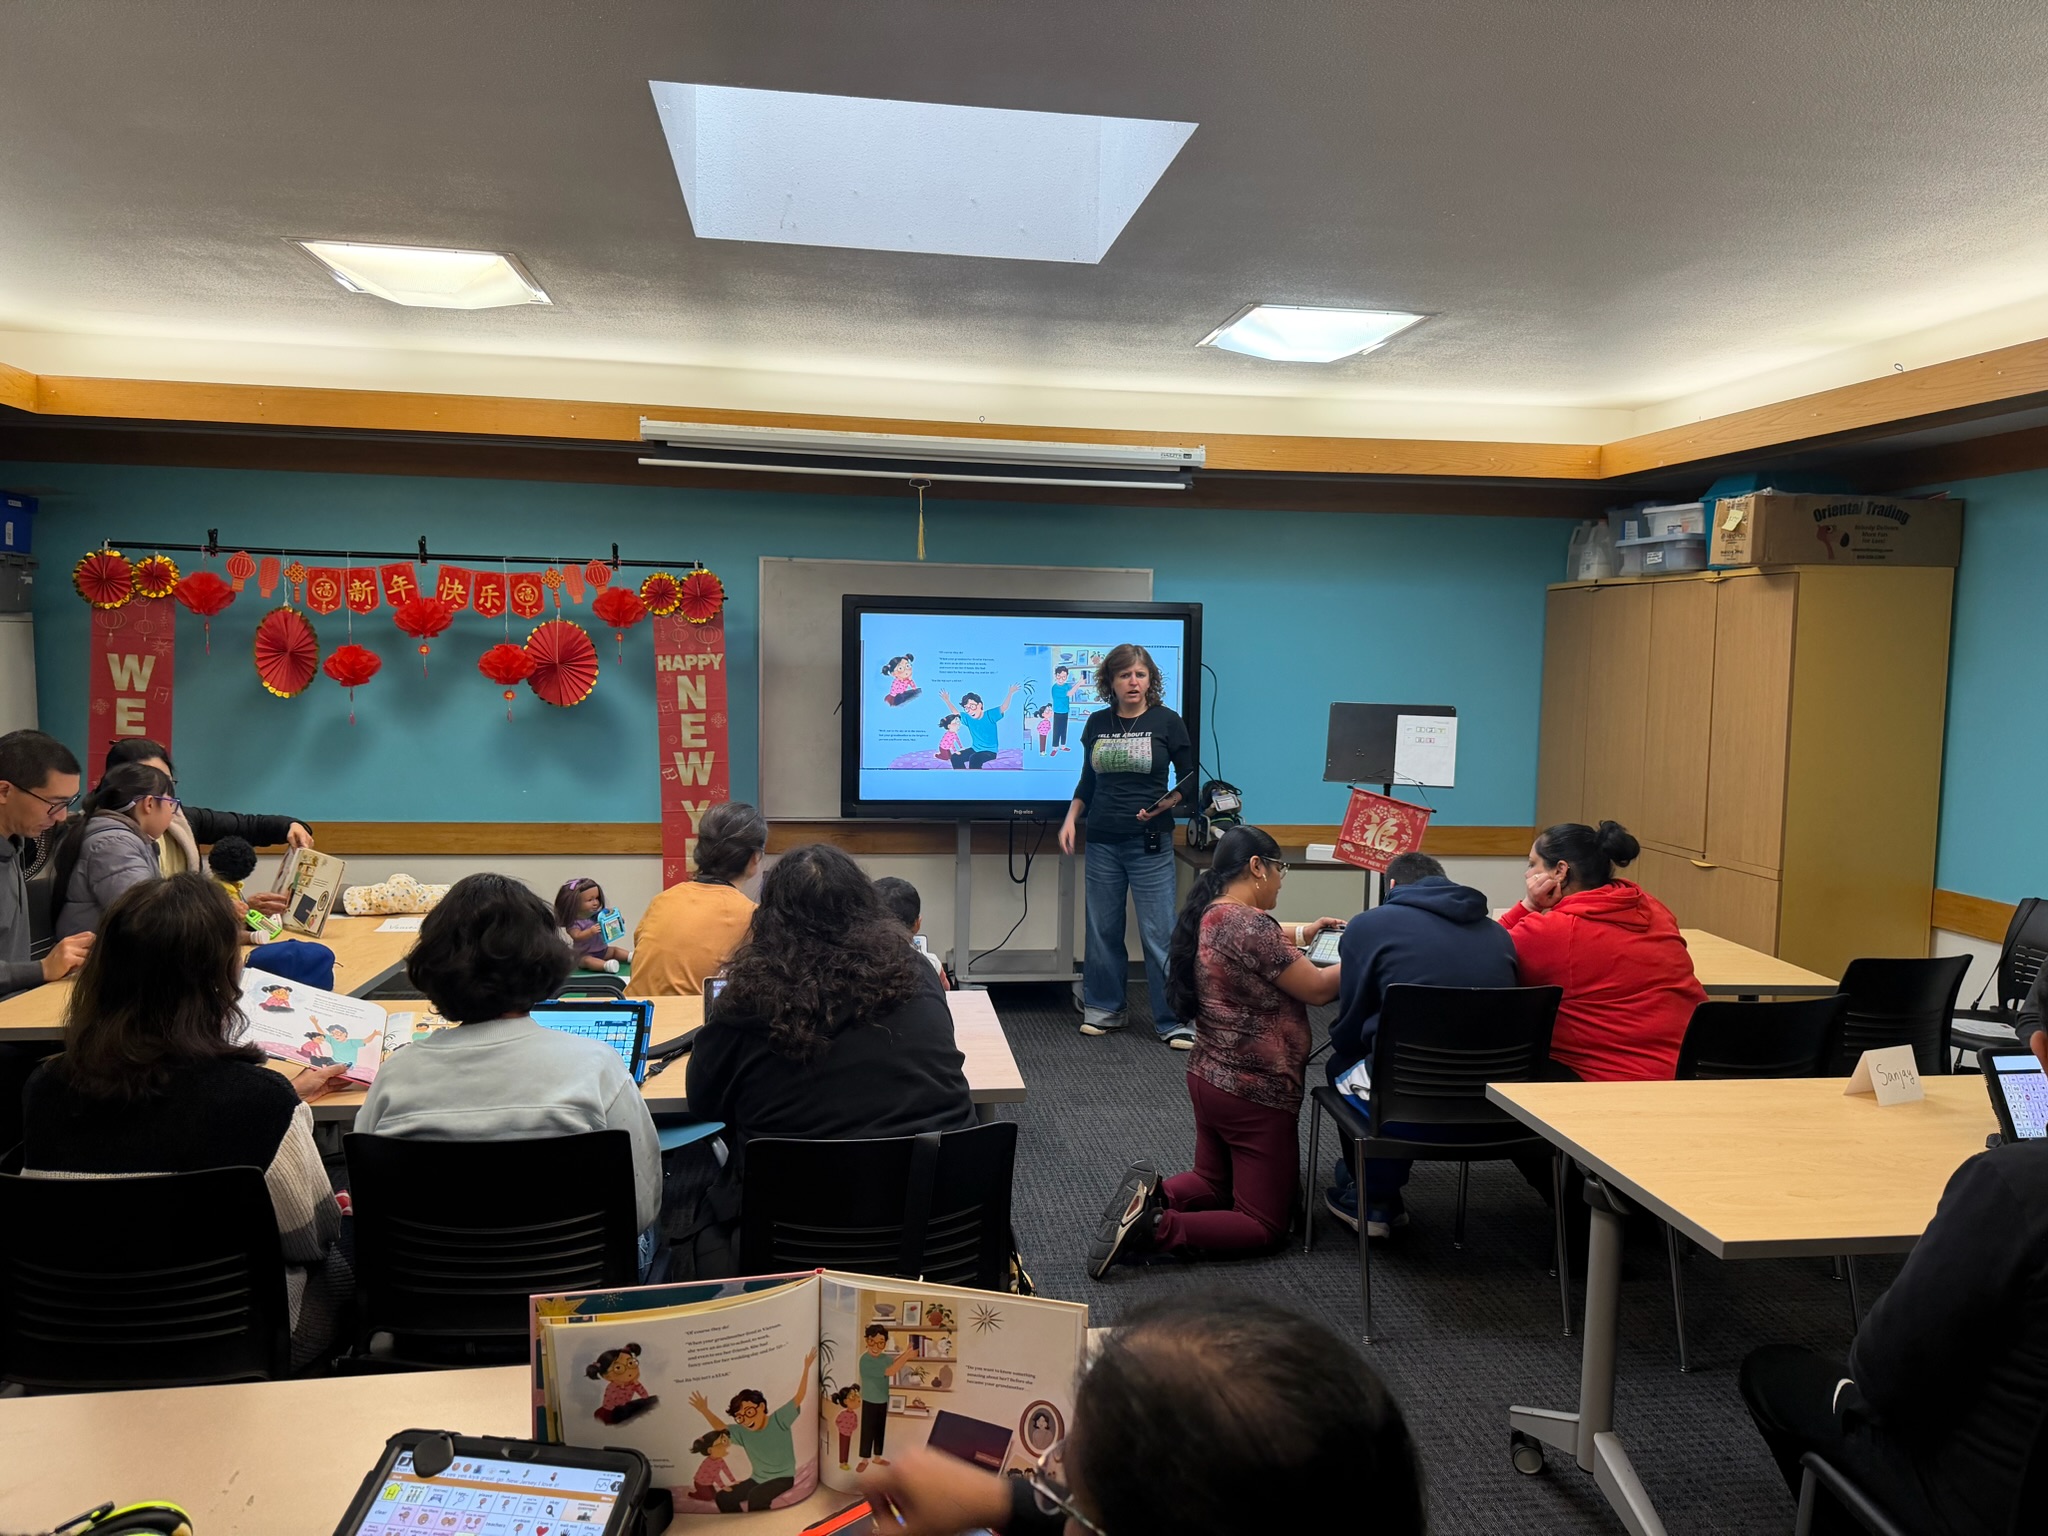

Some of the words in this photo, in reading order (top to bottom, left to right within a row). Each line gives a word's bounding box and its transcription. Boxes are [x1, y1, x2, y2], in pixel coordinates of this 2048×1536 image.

[1813, 501, 1863, 522] Oriental
[1866, 501, 1912, 525] Trading
[657, 653, 724, 672] HAPPY
[673, 674, 716, 787] NEW
[1349, 854, 1368, 864] HAPPY
[1367, 859, 1381, 869] NEW
[519, 1479, 538, 1488] Jersey
